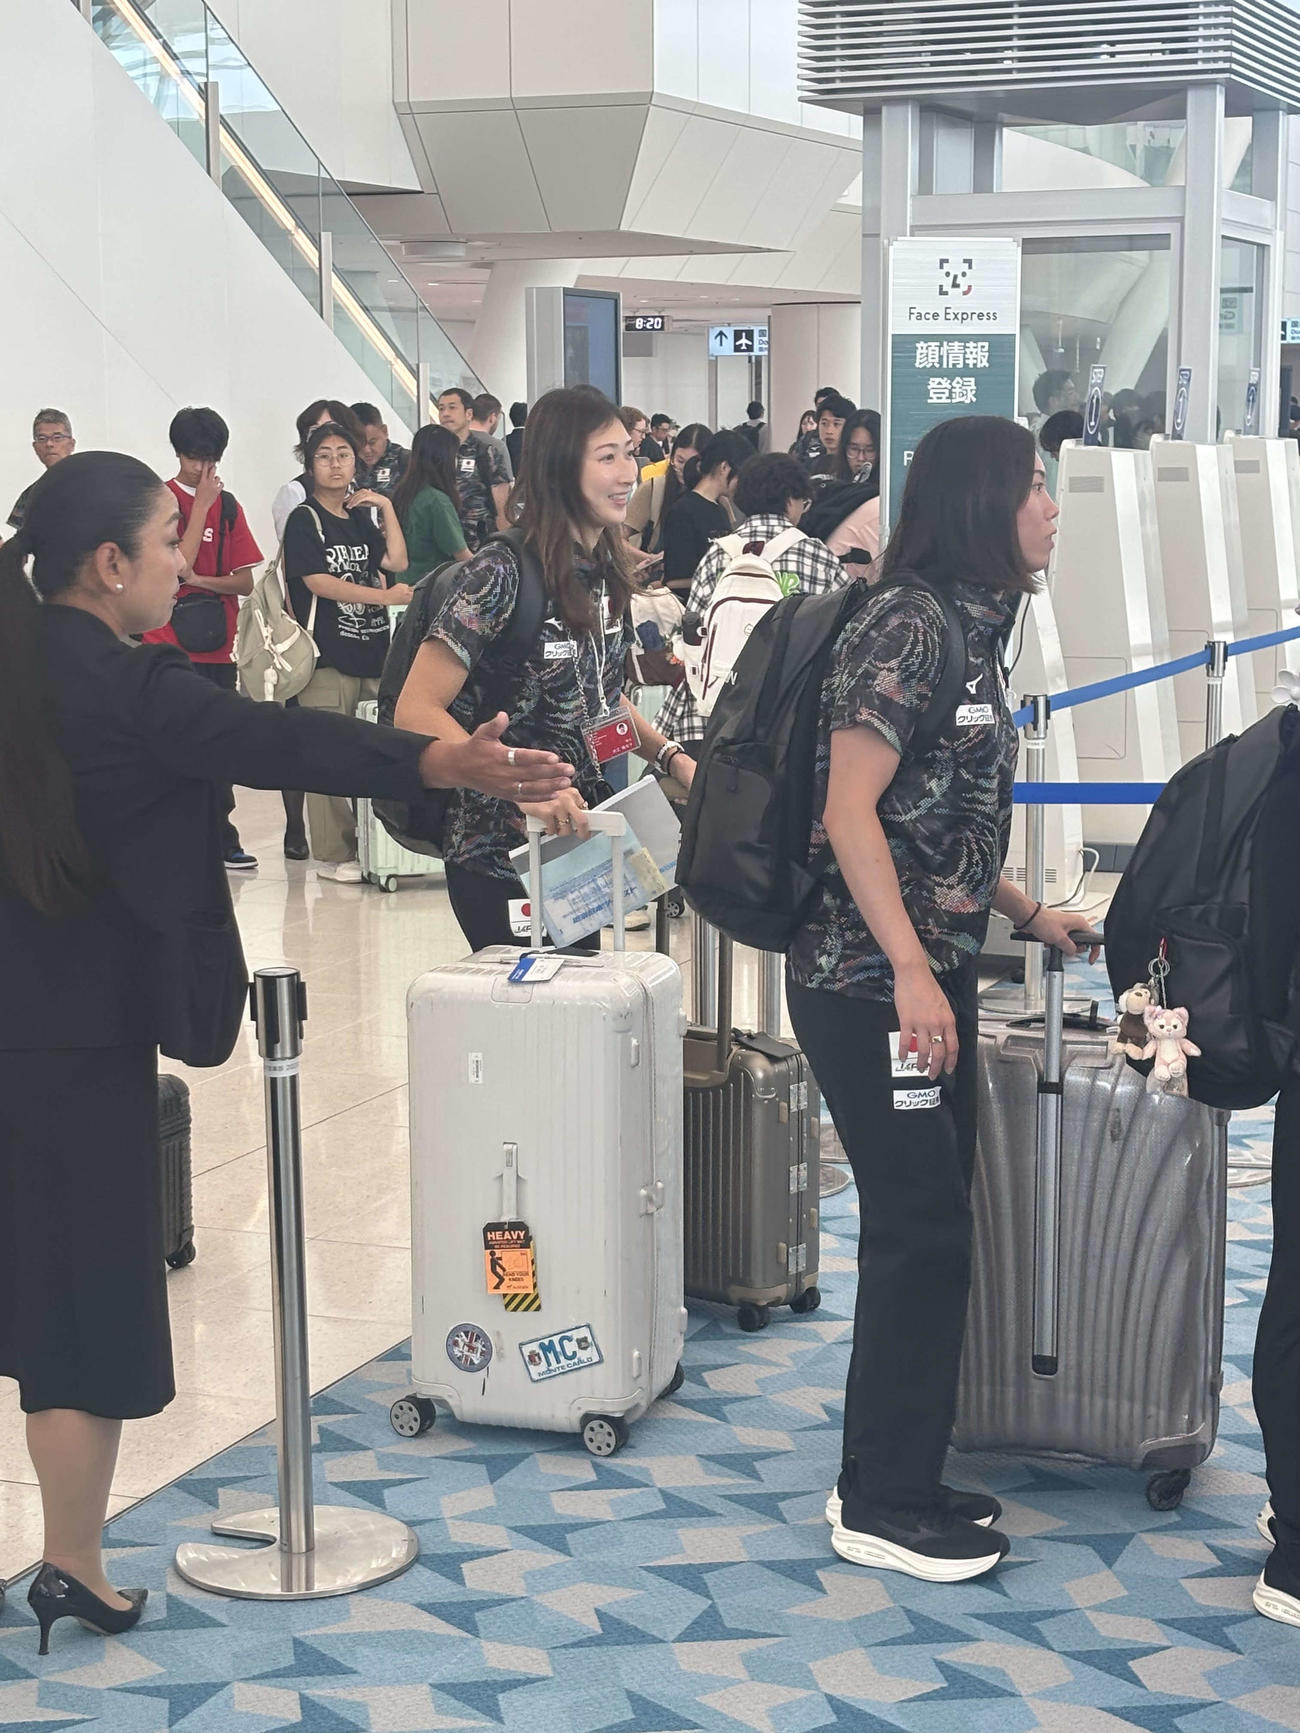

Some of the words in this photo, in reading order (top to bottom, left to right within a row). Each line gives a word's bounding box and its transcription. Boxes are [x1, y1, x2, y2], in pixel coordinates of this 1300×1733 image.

[636, 317, 662, 329] 8:20
[908, 307, 940, 321] Face
[945, 307, 998, 324] Express
[915, 341, 990, 368] 顔情報
[927, 377, 977, 404] 登録
[968, 706, 989, 714] GMO
[907, 1090, 936, 1099] GMO
[487, 1231, 526, 1240] HEAVY
[539, 1335, 577, 1367] MC
[538, 1364, 566, 1377] MONTE
[567, 1357, 593, 1368] CARLO
